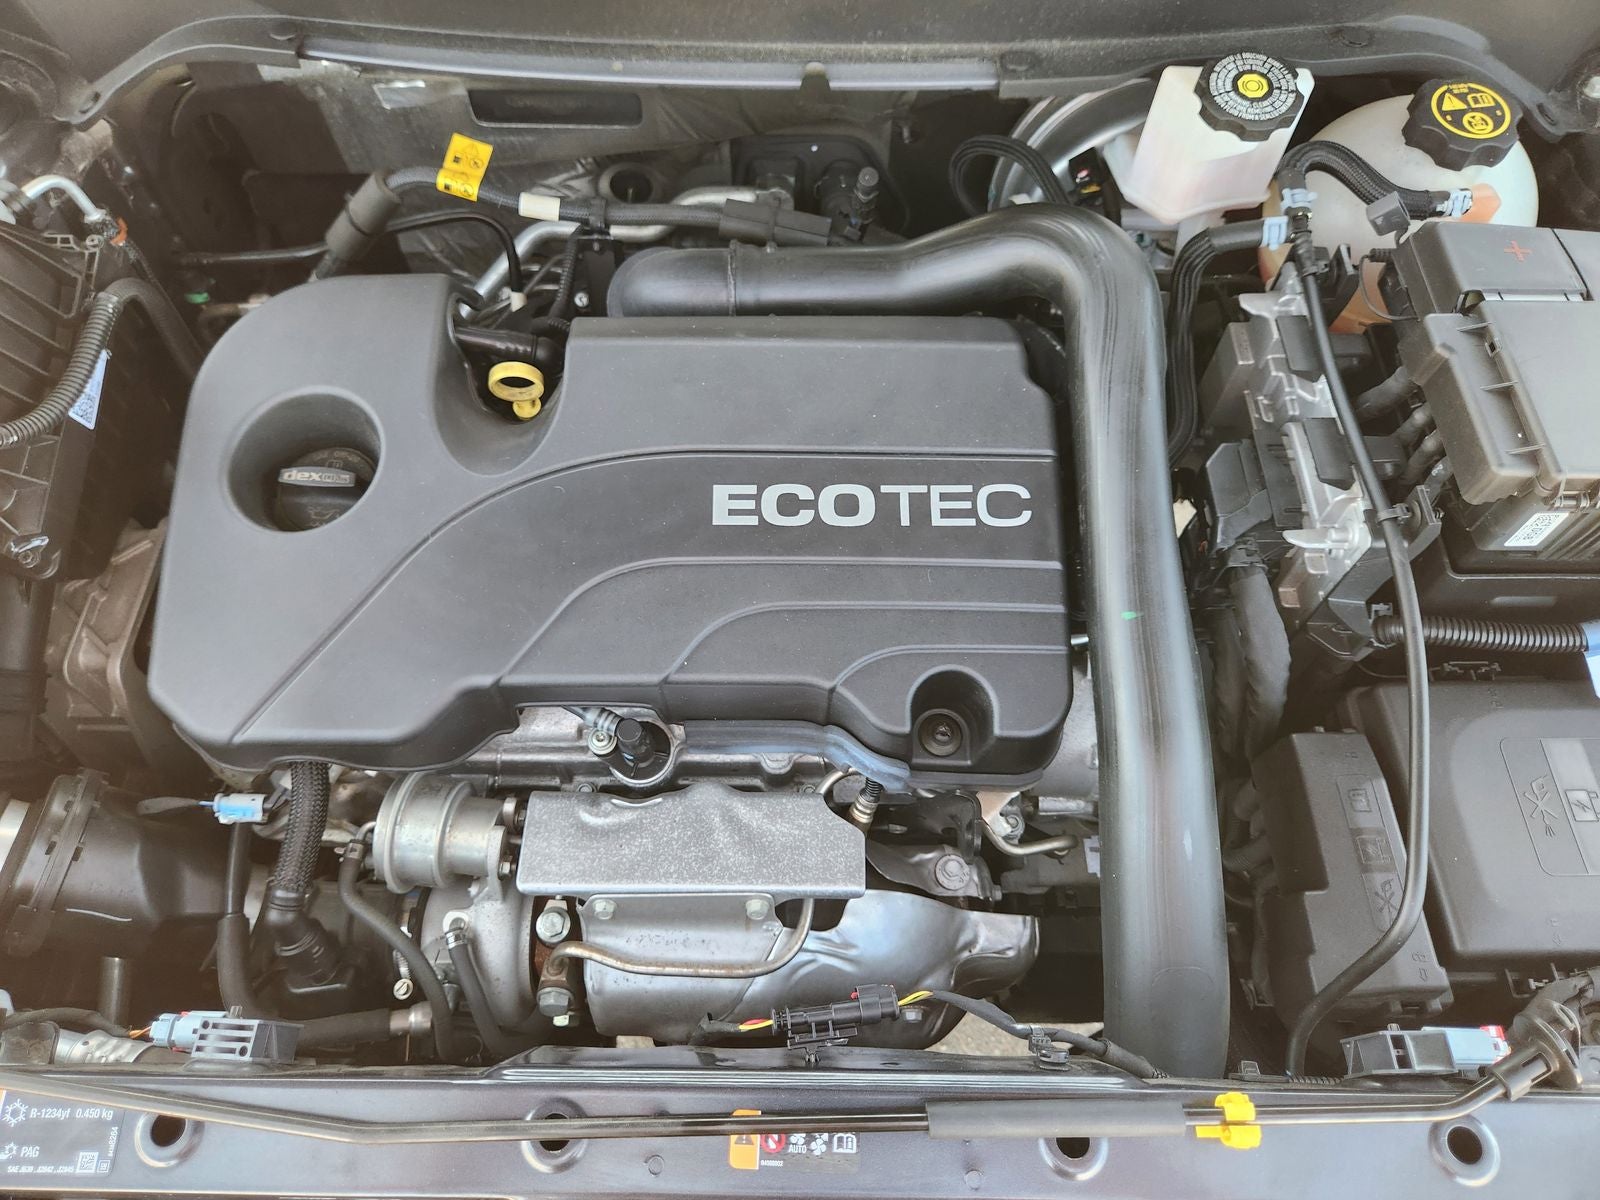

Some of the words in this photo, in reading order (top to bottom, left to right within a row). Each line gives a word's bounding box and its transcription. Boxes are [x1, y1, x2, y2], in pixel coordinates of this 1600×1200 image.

[712, 483, 1033, 527] ECOTEC
[30, 1107, 71, 1120] R-1234yf
[75, 1108, 100, 1118] 0.450
[101, 1108, 113, 1120] kg
[21, 1147, 39, 1157] PAG
[788, 1144, 807, 1154] AUTO
